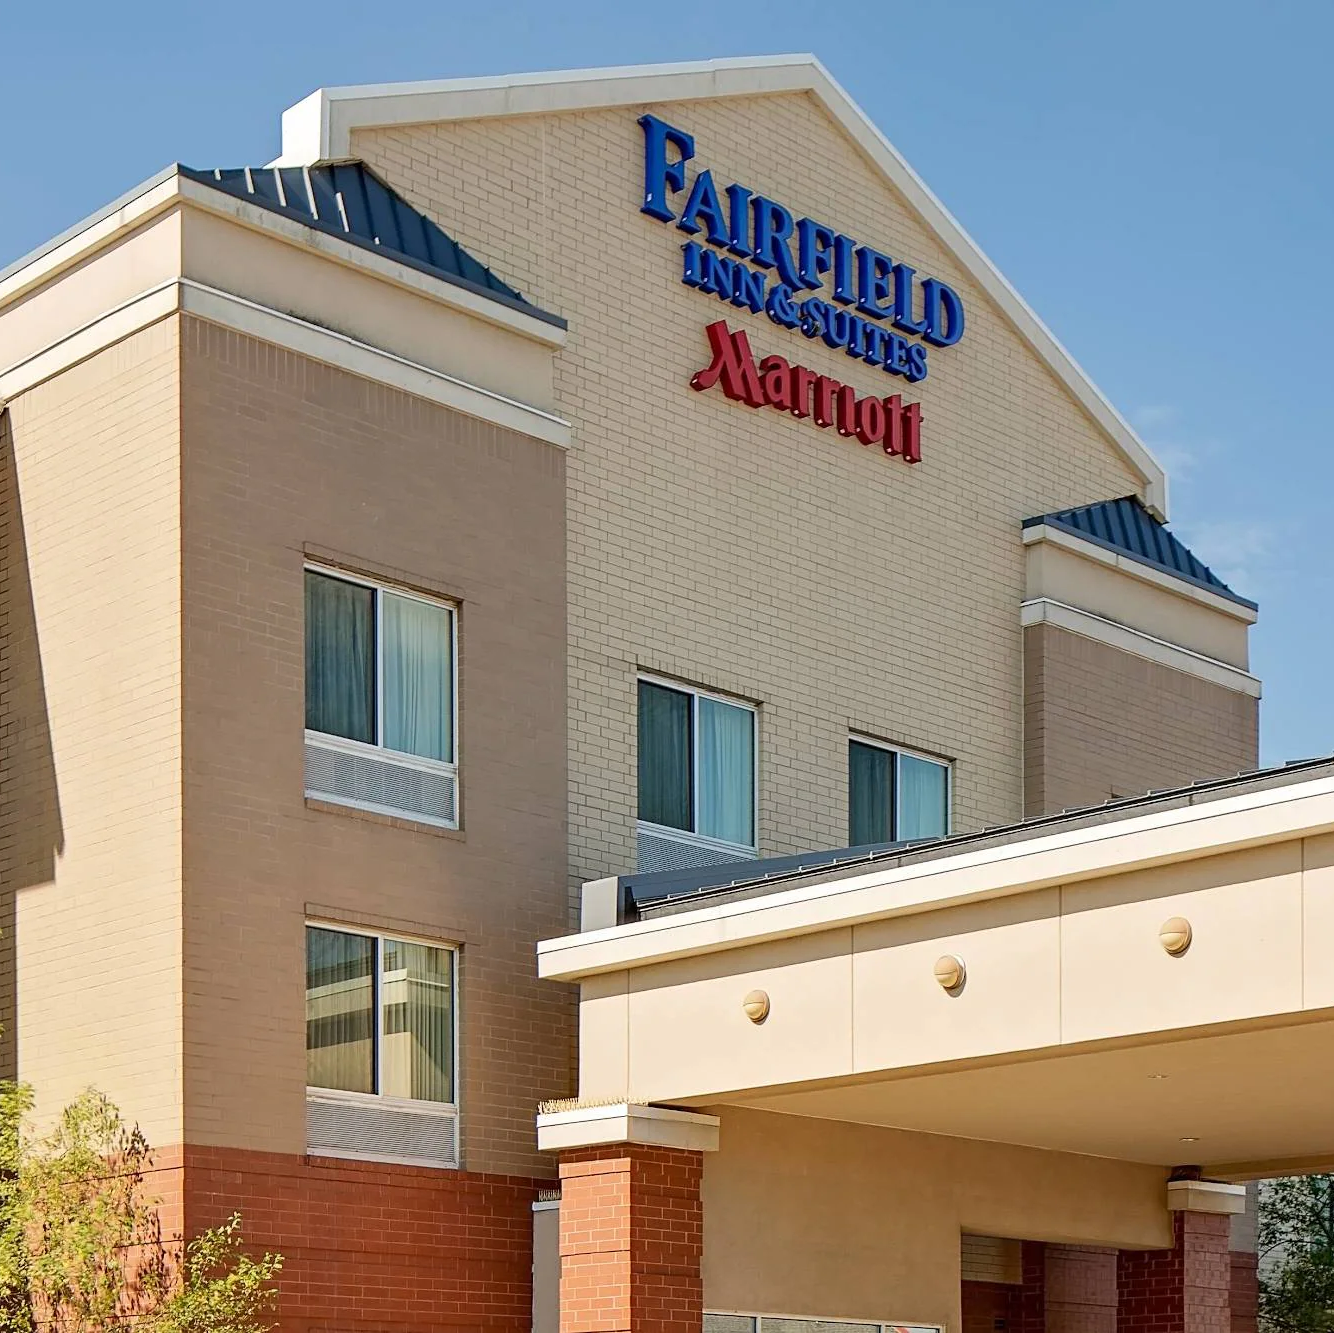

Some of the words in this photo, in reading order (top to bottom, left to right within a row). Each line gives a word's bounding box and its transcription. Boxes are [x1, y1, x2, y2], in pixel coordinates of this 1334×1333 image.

[636, 113, 965, 348] FAIRFIELD
[681, 240, 767, 314] INN
[800, 296, 928, 383] SUITES
[689, 319, 924, 464] Marriott
